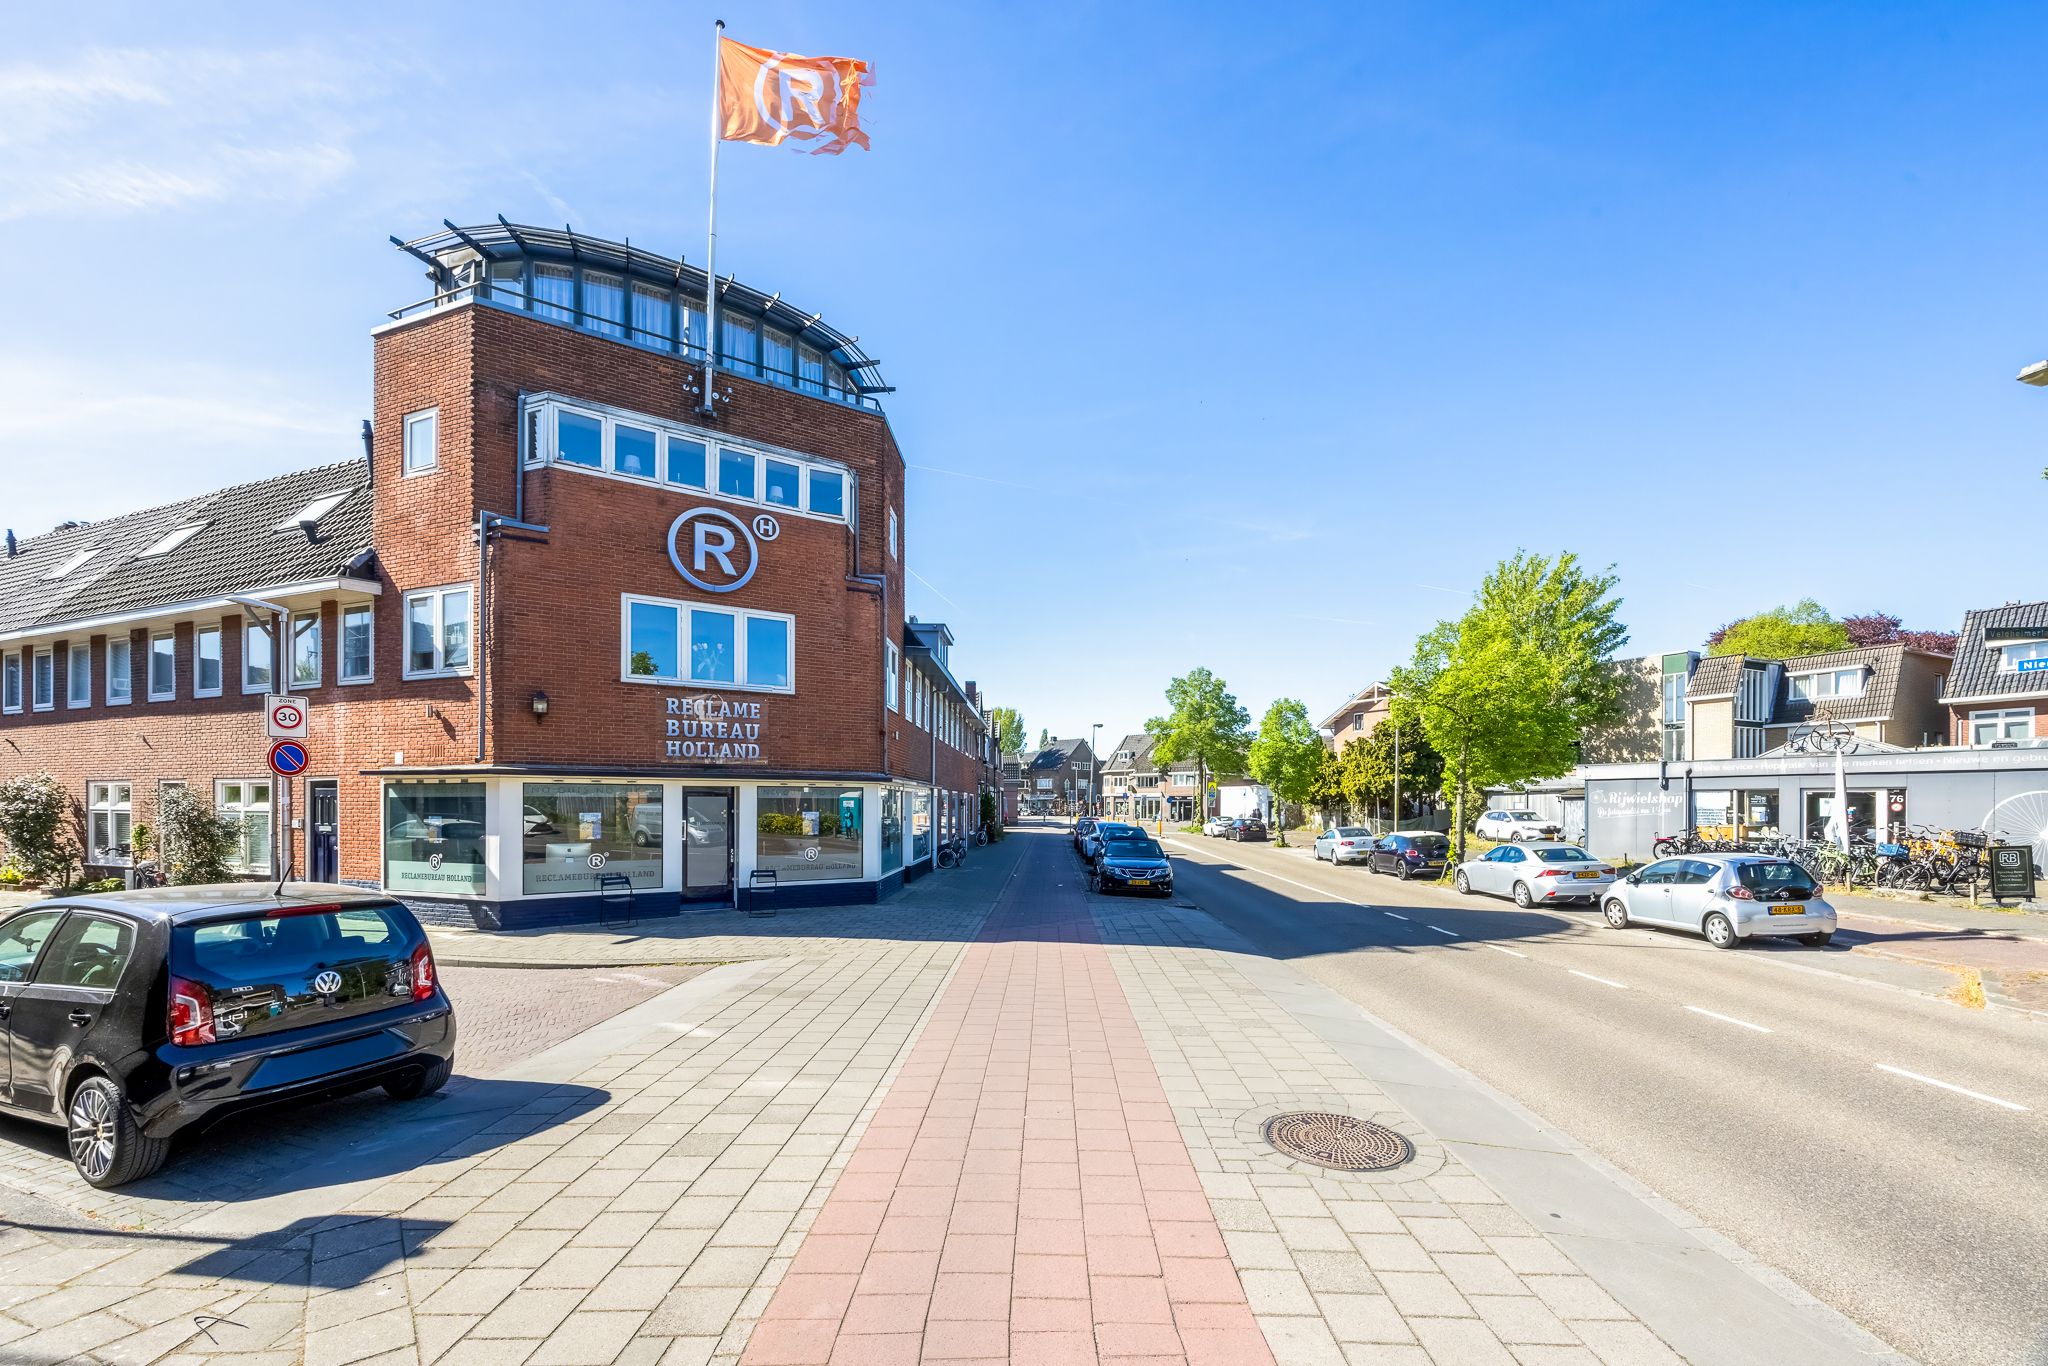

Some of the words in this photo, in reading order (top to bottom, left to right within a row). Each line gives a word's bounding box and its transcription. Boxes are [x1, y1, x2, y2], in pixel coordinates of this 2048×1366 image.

[2023, 661, 2048, 670] Nie
[665, 697, 760, 718] RECLAME
[278, 712, 298, 722] 30
[666, 719, 760, 740] BUREAU
[665, 740, 760, 759] HOLLAND
[1889, 795, 1904, 803] 76
[2001, 853, 2017, 863] RB
[401, 872, 445, 880] RECLAMEBUREAU
[446, 874, 472, 882] HOLLAND
[220, 1010, 248, 1022] up!
